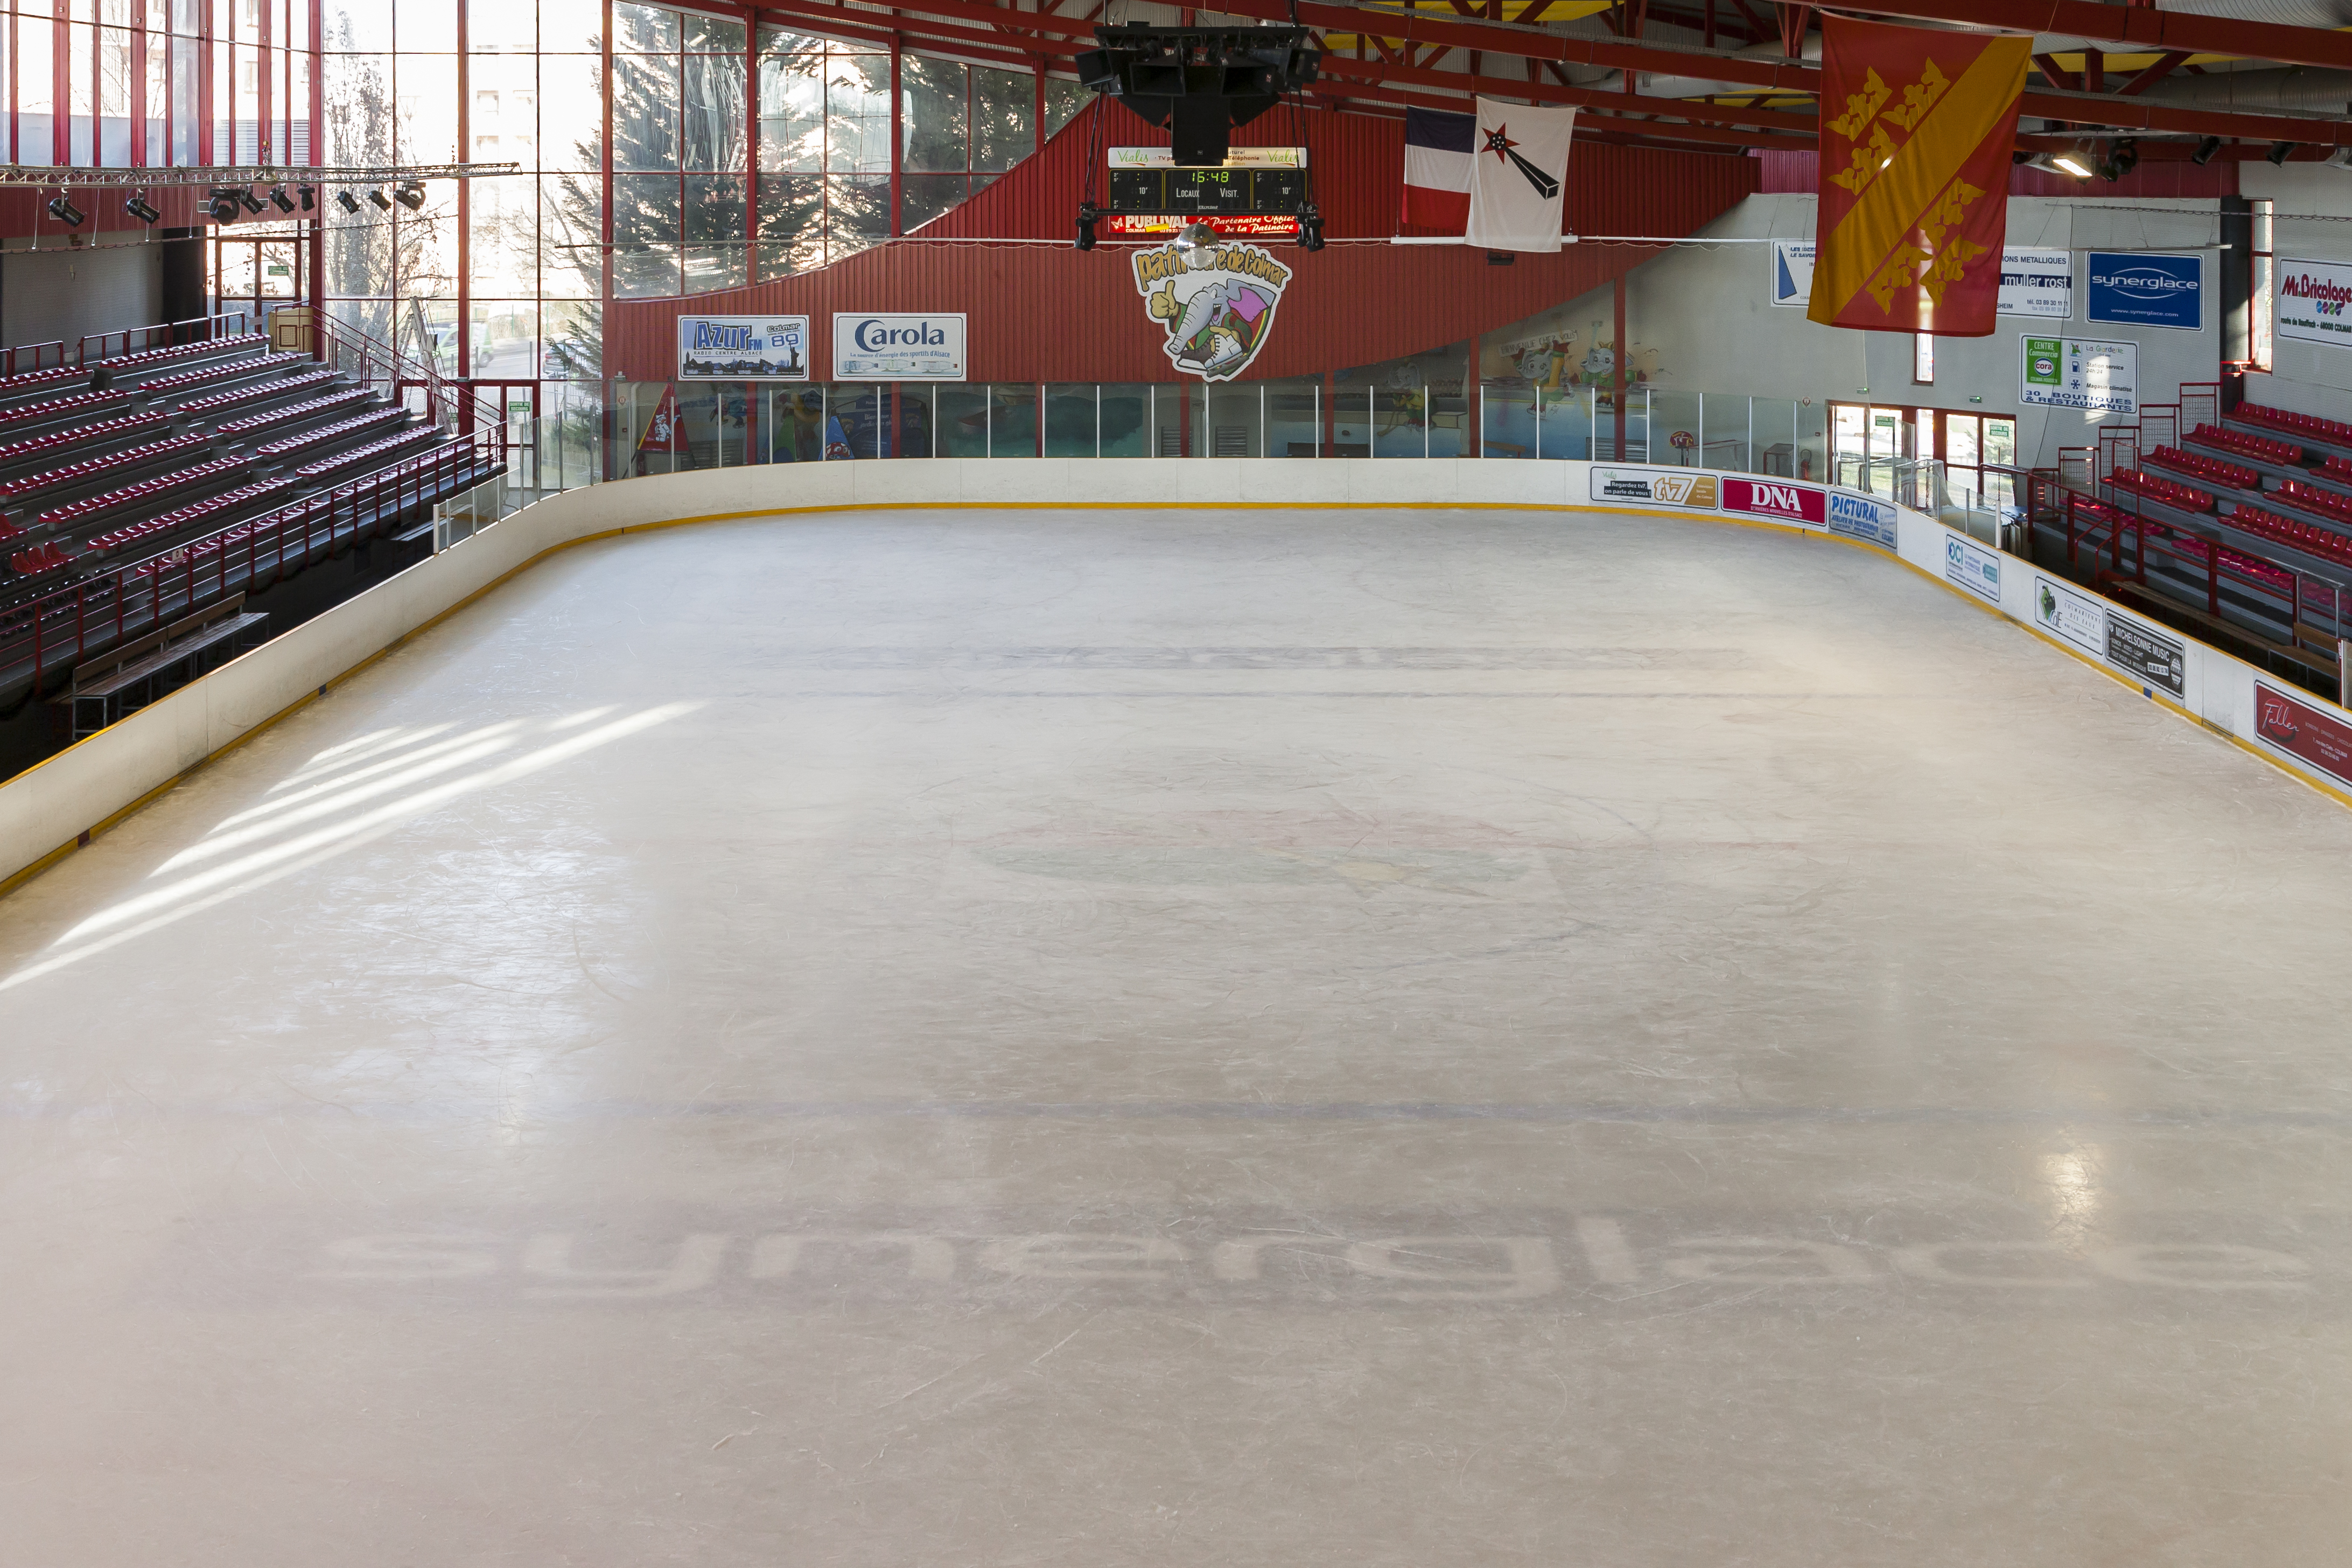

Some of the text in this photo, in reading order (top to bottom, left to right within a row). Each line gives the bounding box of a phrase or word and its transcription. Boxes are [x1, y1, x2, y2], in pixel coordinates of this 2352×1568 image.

[1117, 149, 1149, 163] Vialis
[1210, 216, 1262, 228] Partenaire
[1225, 223, 1294, 234] de la Patinoire
[1227, 244, 1244, 271] de
[1244, 248, 1288, 288] Colmar
[2020, 256, 2067, 264] METALLIQUES
[2005, 274, 2068, 289] muller rost
[2092, 275, 2198, 290] synerglace
[2111, 309, 2179, 317] www.synerglace.com
[767, 323, 801, 333] Colmar
[694, 321, 762, 351] Azur FM
[771, 333, 799, 347] 89
[855, 319, 944, 353] Carola
[2034, 341, 2055, 351] CENTRE
[2096, 345, 2125, 354] Garderie
[909, 351, 929, 359] sportifs
[2038, 397, 2132, 412] RESTAURANTS
[2052, 392, 2132, 405] BOUTIQUES
[1654, 477, 1692, 502] tv7
[1751, 484, 1803, 512] DNA
[1832, 495, 1879, 524] PICTURAL
[2064, 602, 2101, 625] COLMARIENNE
[2070, 612, 2078, 622] DES
[2115, 626, 2152, 654] MICHELSONNE
[2152, 645, 2170, 662] MUSIC
